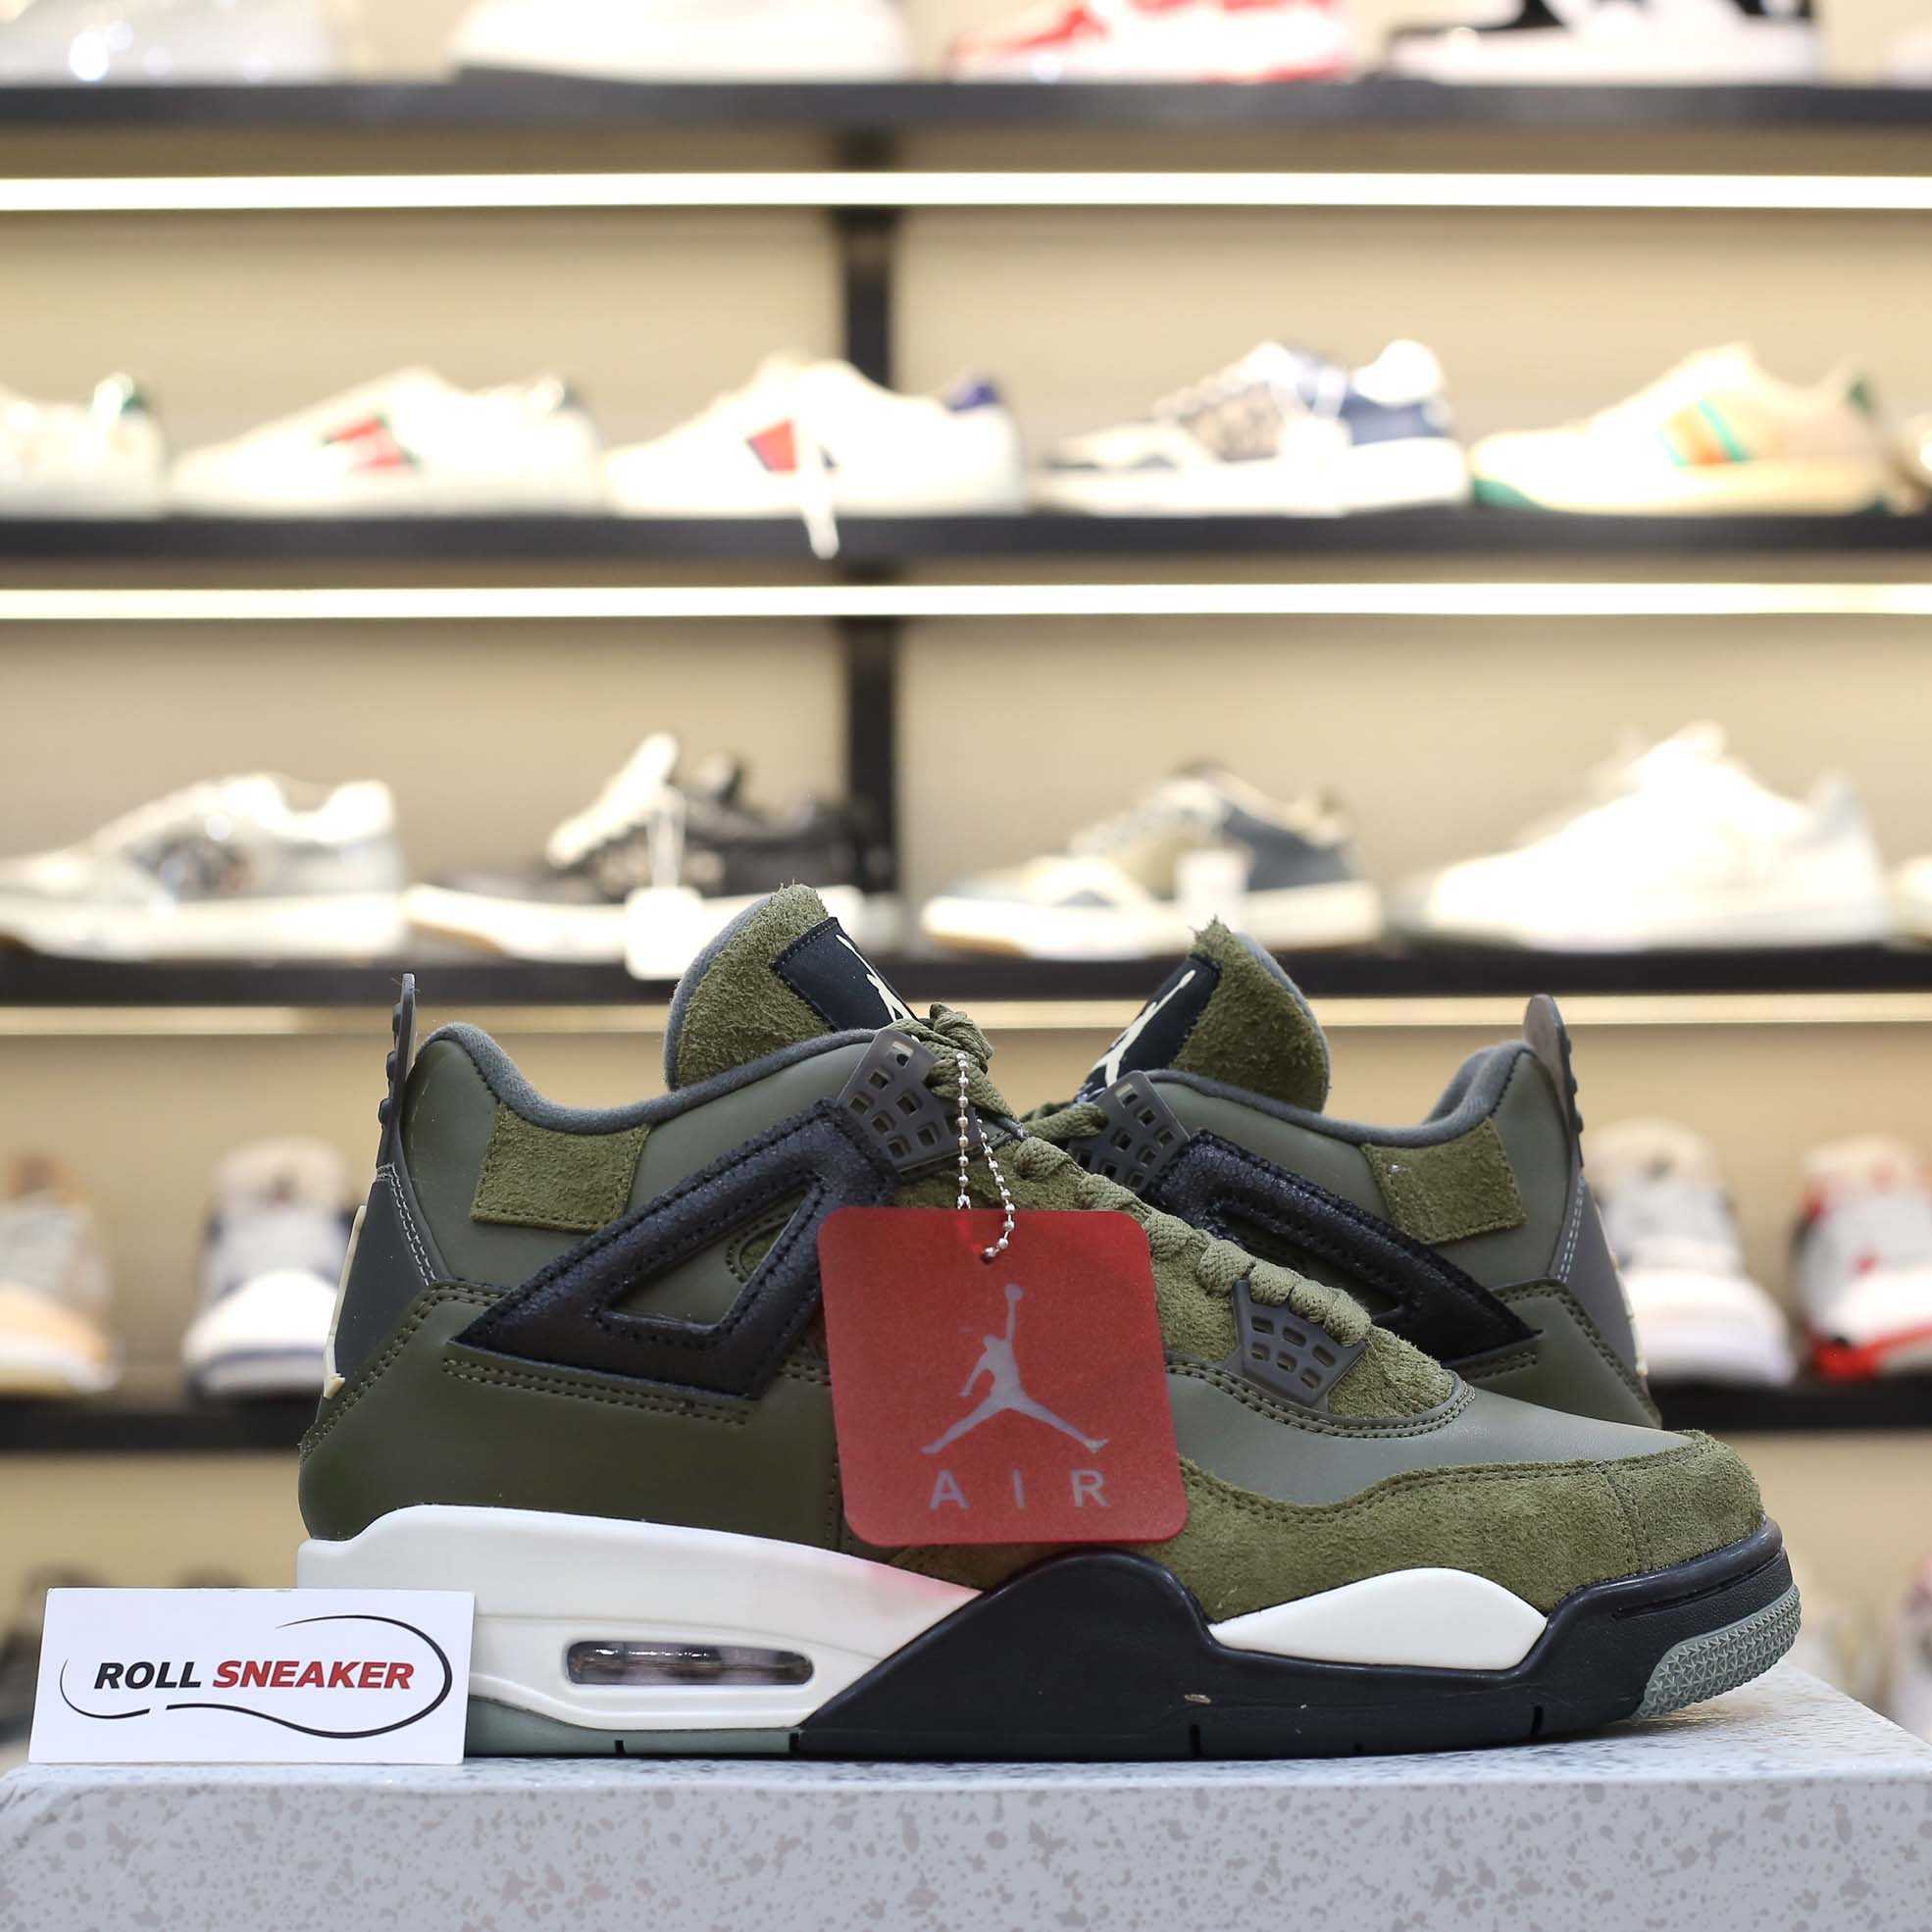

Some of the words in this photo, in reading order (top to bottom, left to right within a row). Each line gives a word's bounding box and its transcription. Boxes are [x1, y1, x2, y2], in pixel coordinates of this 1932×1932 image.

[930, 1469, 1110, 1510] AIR
[94, 1661, 201, 1690] ROLL
[212, 1659, 415, 1690] SNEAKER
